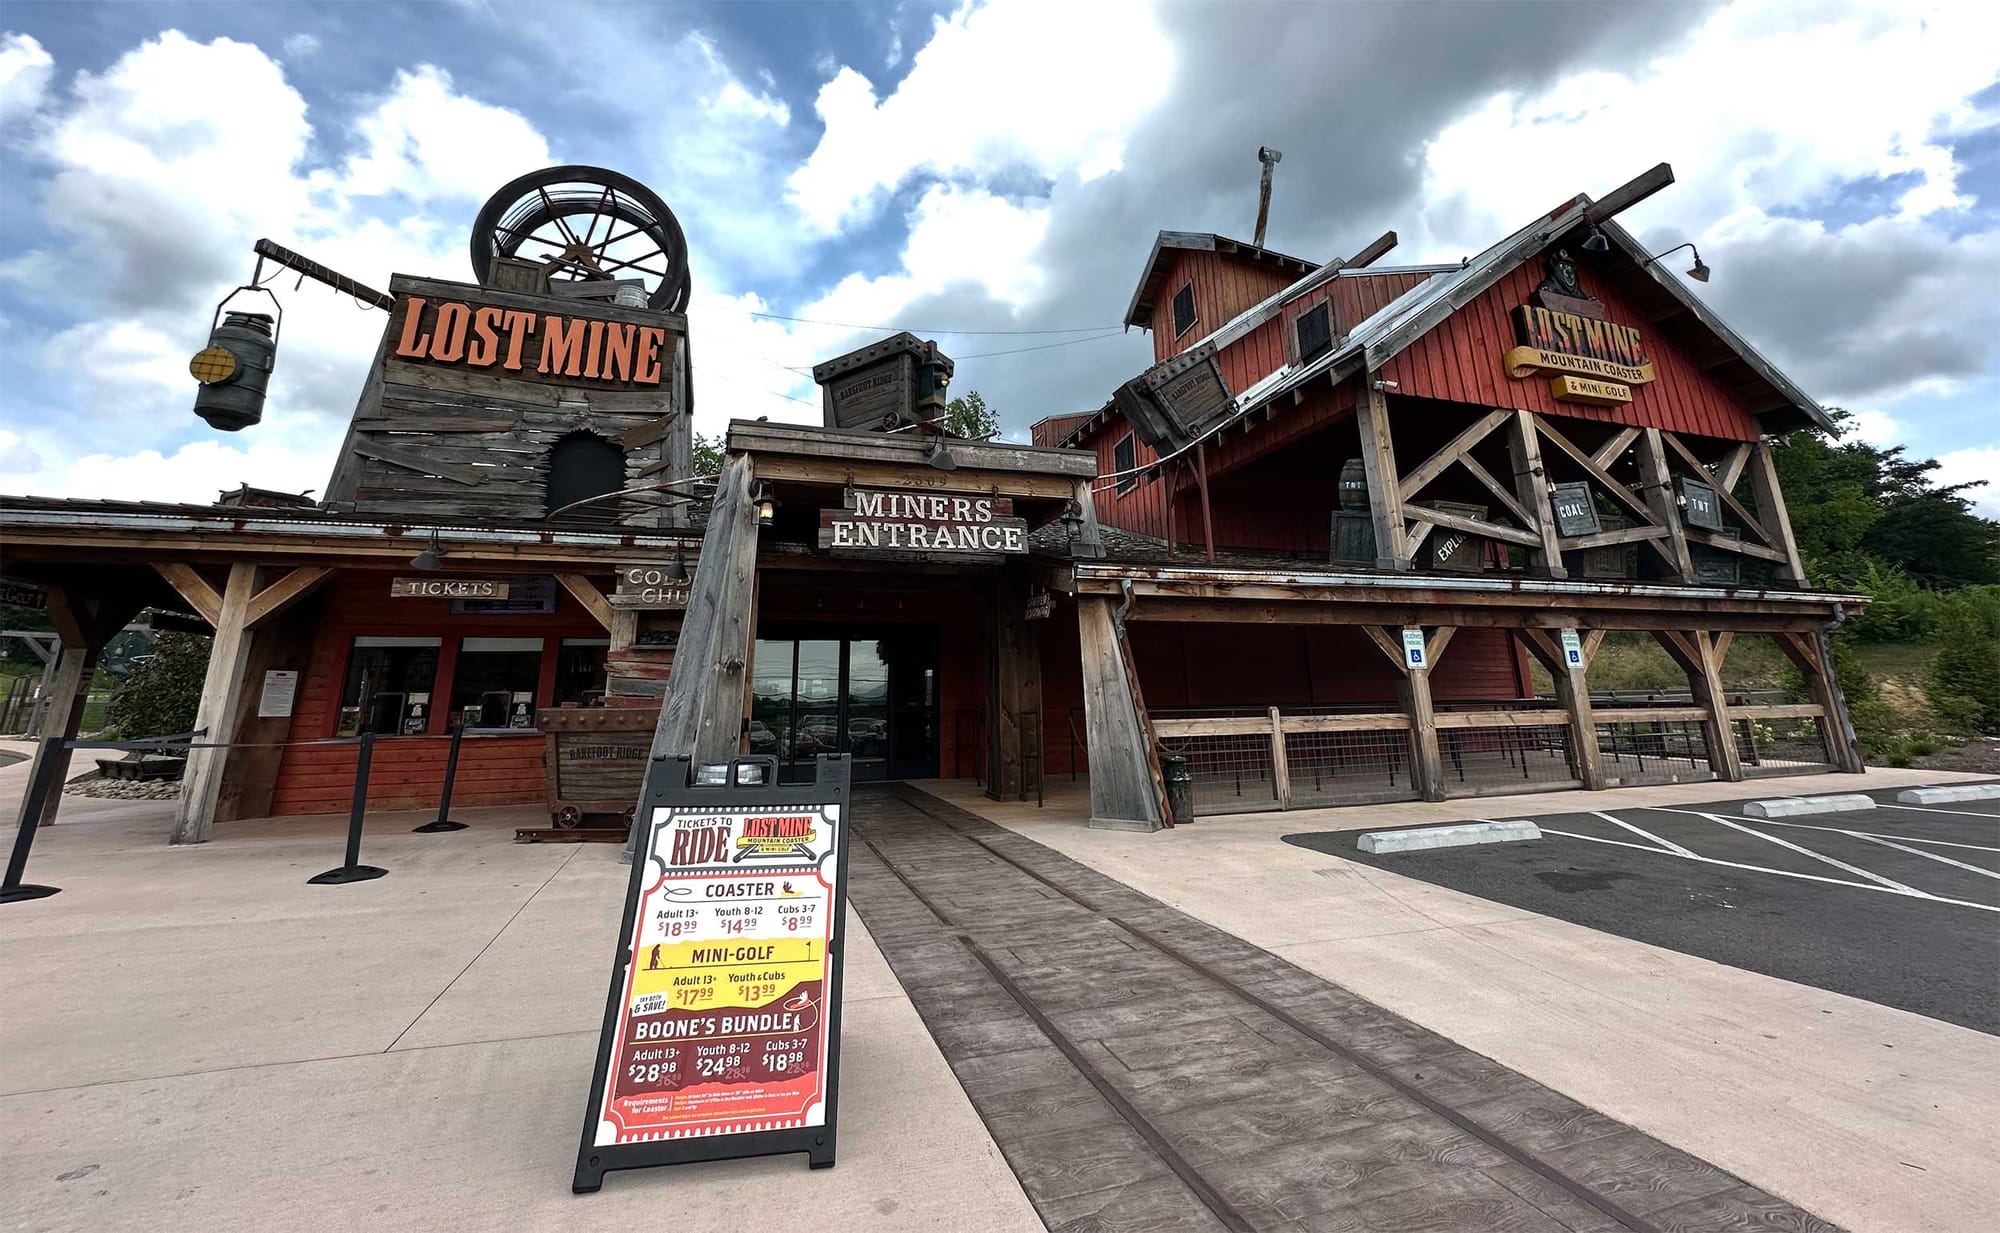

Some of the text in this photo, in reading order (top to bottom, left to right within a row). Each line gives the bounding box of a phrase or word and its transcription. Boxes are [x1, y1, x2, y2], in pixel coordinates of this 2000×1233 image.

[396, 297, 666, 384] LOST MINE
[1523, 304, 1650, 367] LOST MINE
[1540, 352, 1645, 381] MOUNTAIN COASTER
[1571, 381, 1628, 398] & MINI GOLF
[1345, 481, 1361, 489] TNT
[853, 492, 992, 523] MINERS
[1559, 503, 1584, 519] COAL
[1691, 498, 1710, 513] TNT
[831, 521, 1023, 551] ENTRANCE
[408, 582, 493, 596] TICKETS
[641, 587, 691, 605] CHU
[569, 746, 644, 761] BAREFOOT RIDGE
[677, 816, 733, 829] TICKETS TO
[743, 817, 813, 838] LOST MINE
[670, 827, 731, 866] RIDE
[782, 836, 810, 844] COASTER
[705, 882, 775, 898] COASTER
[656, 909, 684, 919] Adult
[715, 906, 764, 917] Youth 8-12
[778, 904, 816, 915] Cubs 3-7
[691, 945, 775, 964] MINI-GOLF
[673, 975, 700, 986] Adult
[728, 972, 755, 983] Youth
[763, 971, 786, 981] Cubs
[634, 1000, 666, 1014] & SAVE!
[635, 1013, 793, 1040] BOONE'S BUNDLE
[697, 1043, 751, 1057] Youth 8-12
[766, 1038, 808, 1051] Cubs 3-7
[633, 1048, 681, 1061] Adult 13+
[623, 1097, 669, 1109] Requirements
[631, 1107, 642, 1115] for
[642, 1105, 668, 1114] Coaster
